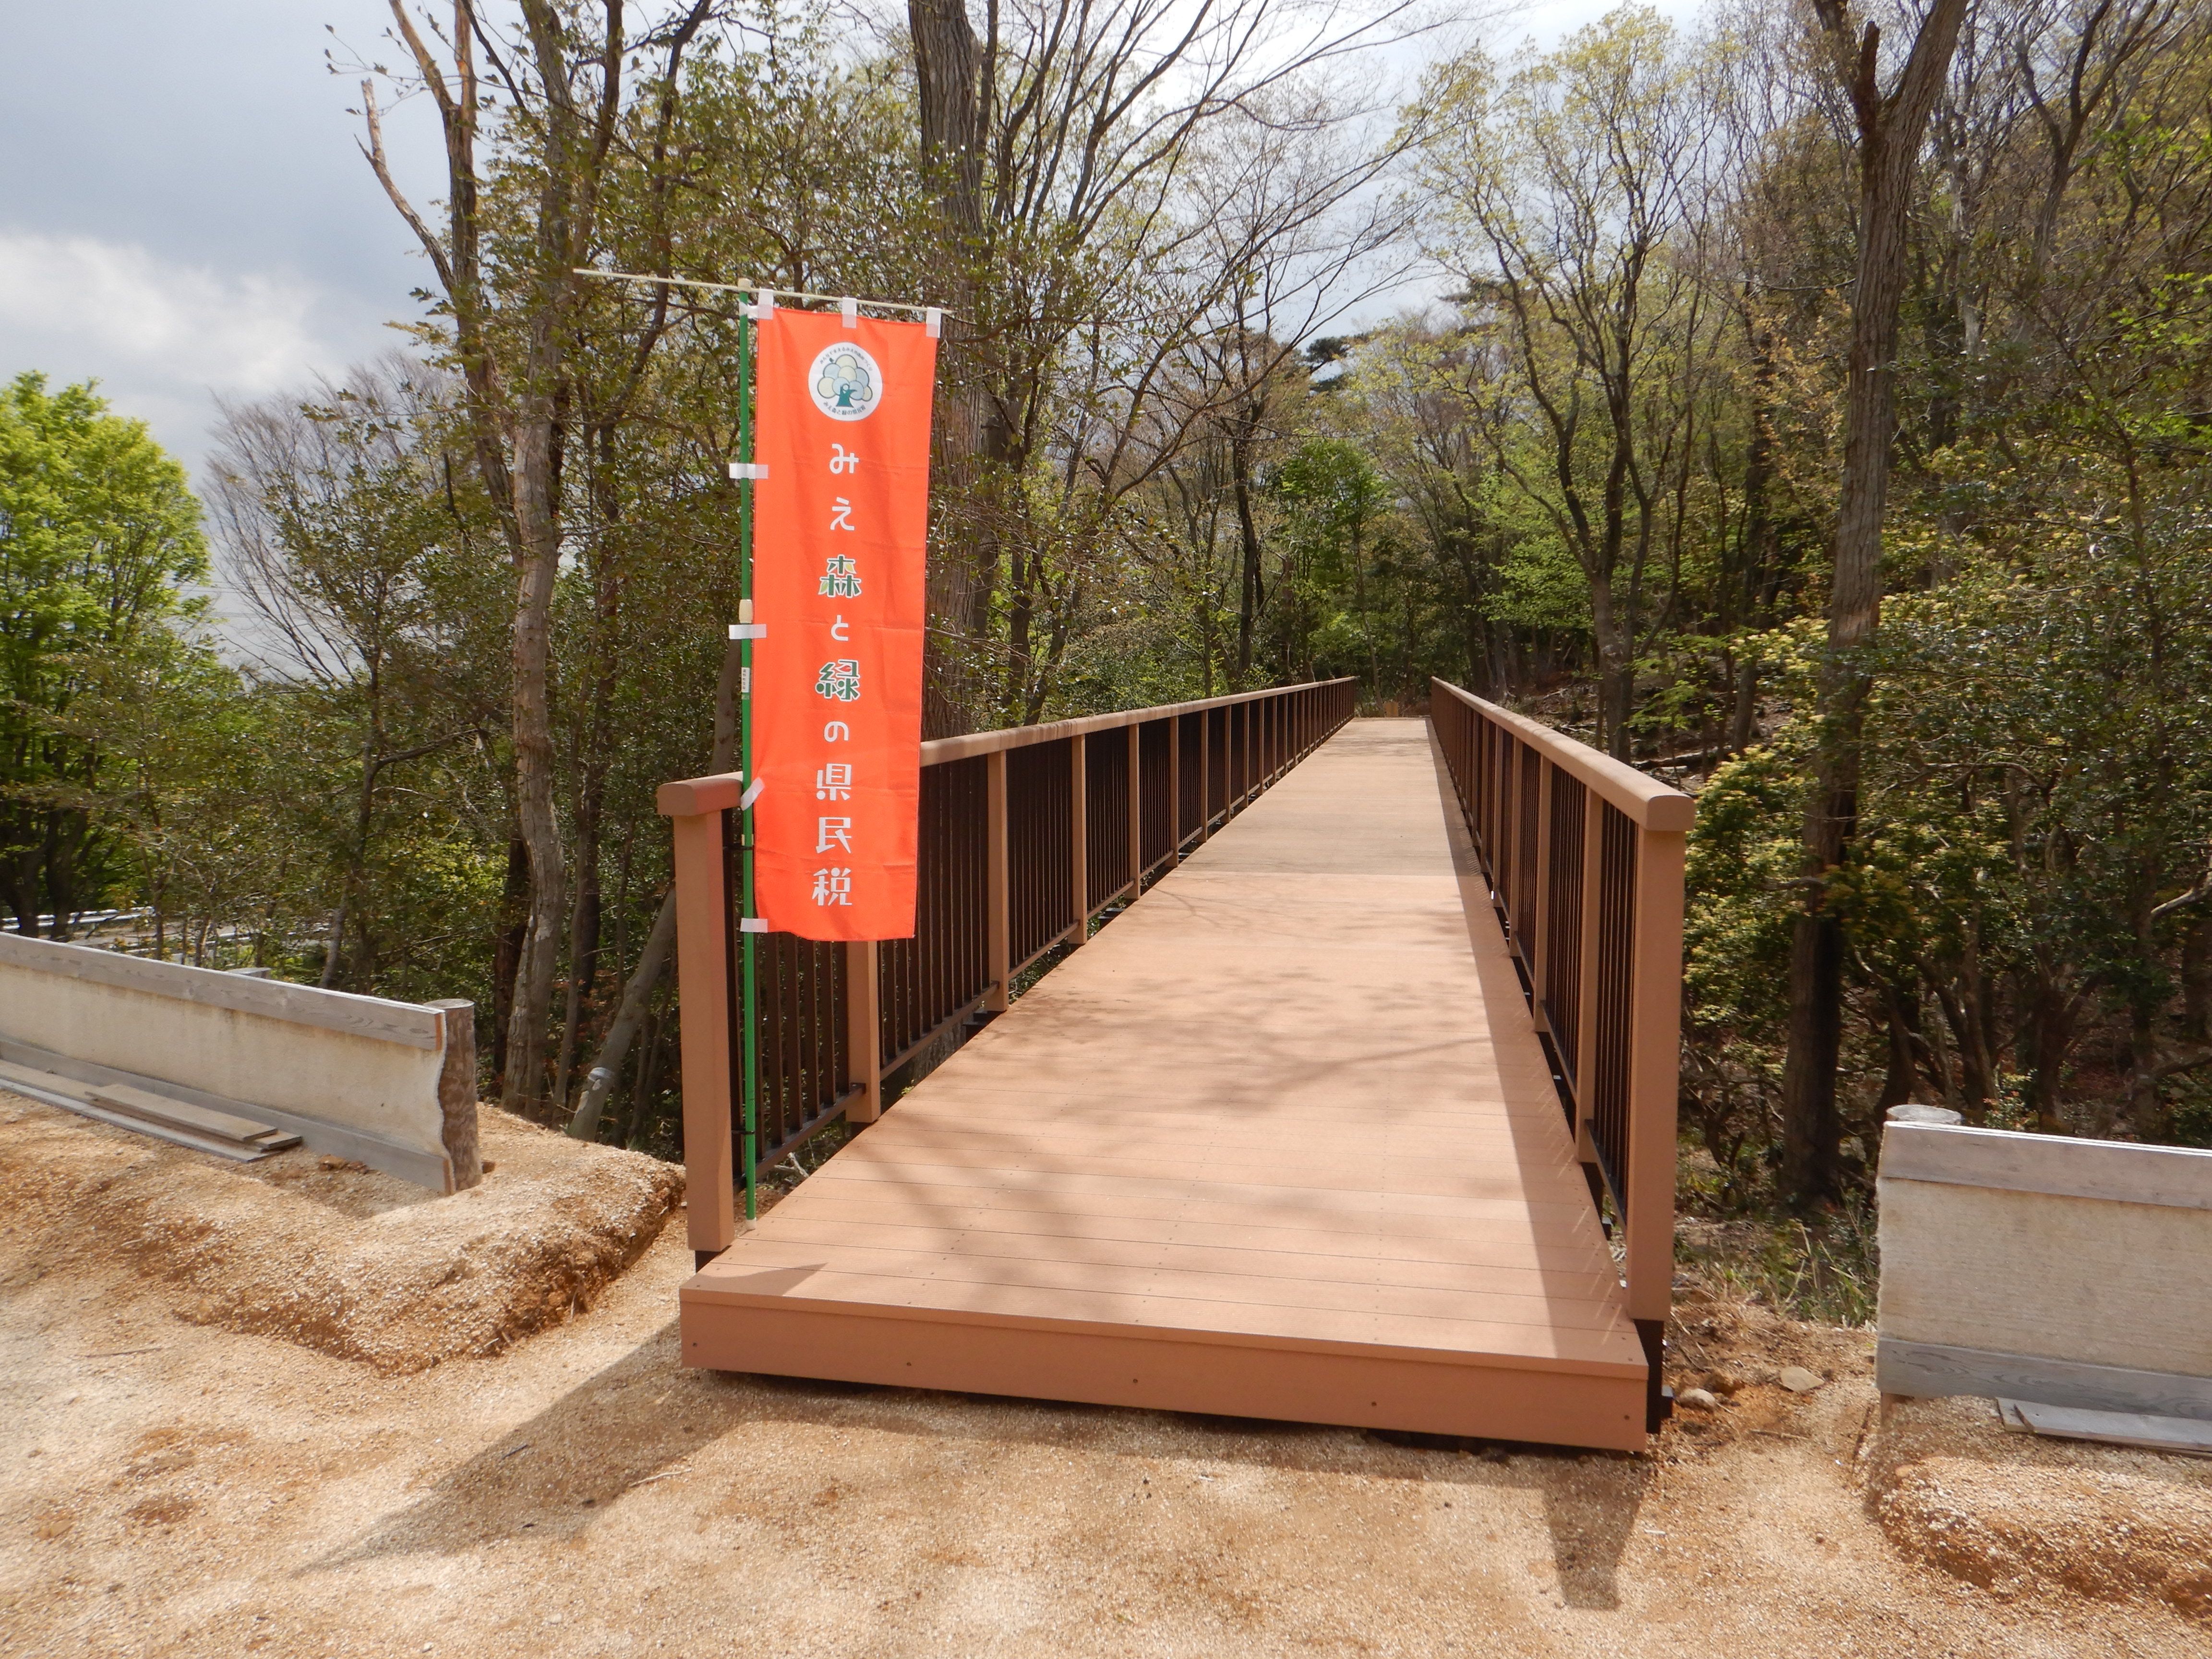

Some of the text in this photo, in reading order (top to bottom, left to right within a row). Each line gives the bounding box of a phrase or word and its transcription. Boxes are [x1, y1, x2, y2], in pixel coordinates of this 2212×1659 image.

[823, 401, 866, 415] みえ森と緑の県民税
[811, 443, 862, 906] みえ森と緑の県民税
